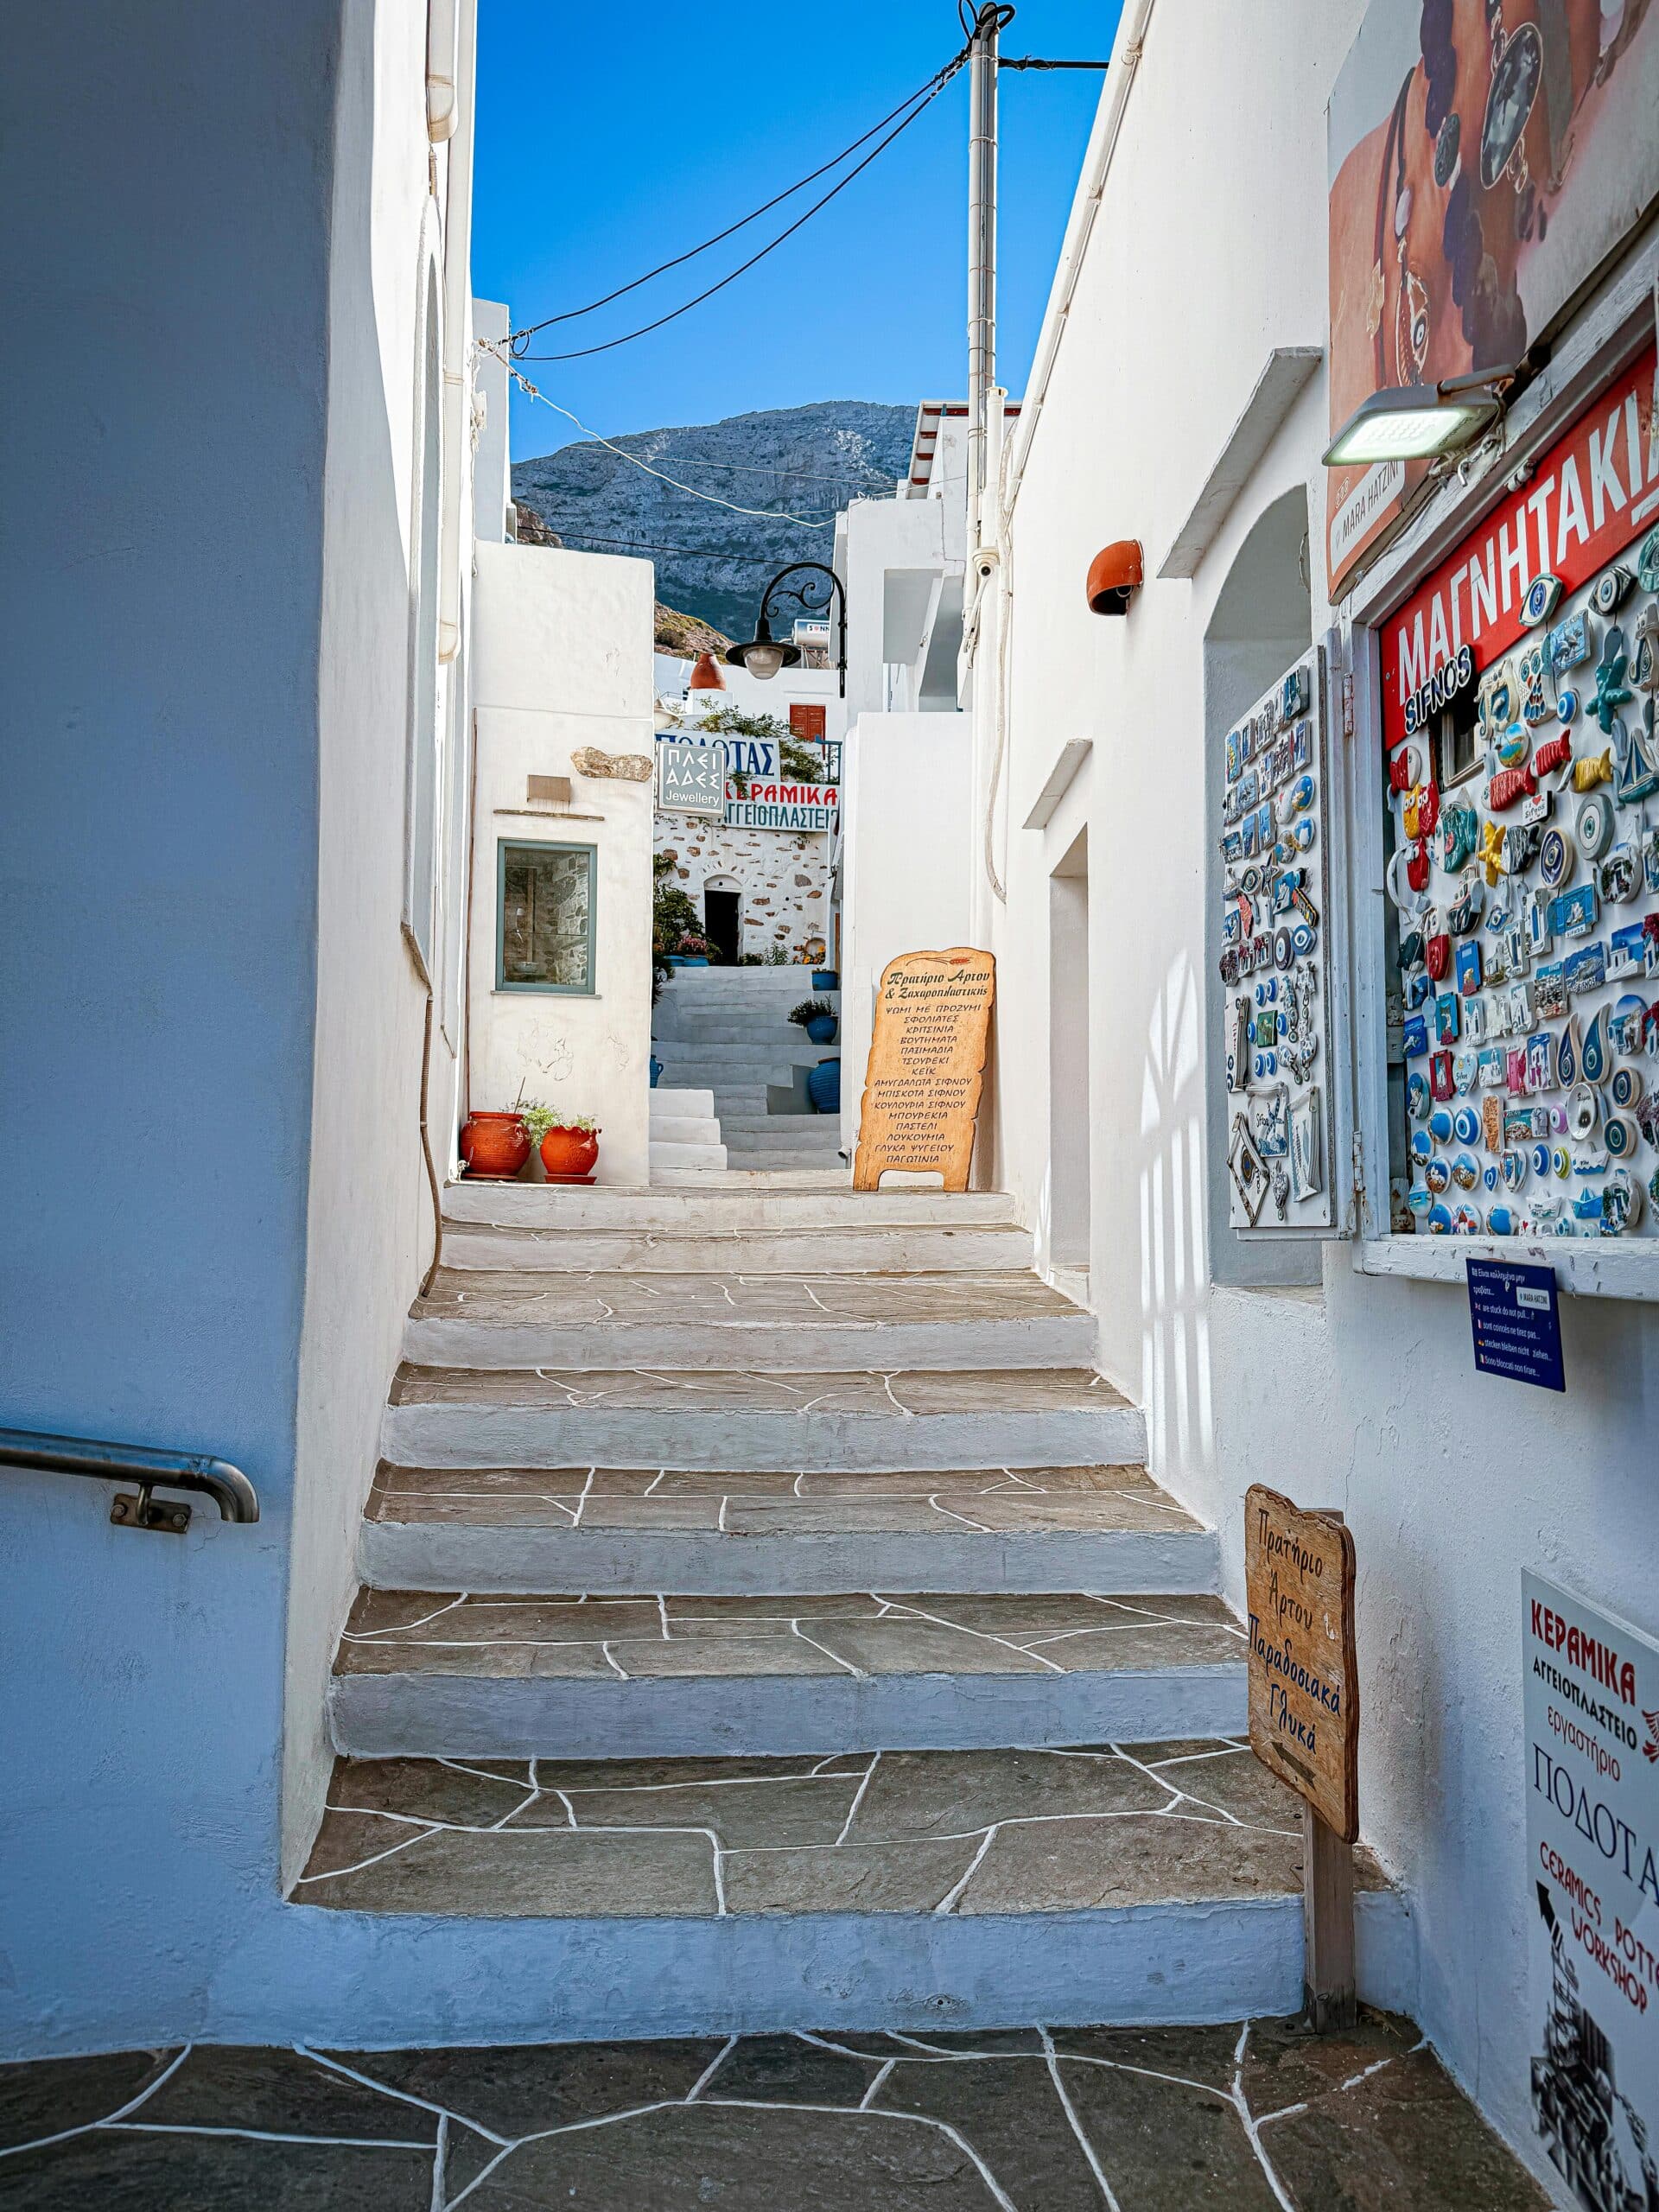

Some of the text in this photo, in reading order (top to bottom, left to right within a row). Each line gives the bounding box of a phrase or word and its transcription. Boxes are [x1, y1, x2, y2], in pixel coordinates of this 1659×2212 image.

[1343, 496, 1365, 543] MARA
[1405, 644, 1472, 734] SIFNOS
[668, 749, 716, 770] ΠΛΕΙ
[665, 768, 720, 790] ΑΔΕΣ
[665, 790, 719, 807] Jewellery
[887, 972, 944, 987] Πρατήριο
[886, 985, 988, 1000] & Ζαχαροπλαστικής
[904, 1014, 960, 1024] ΣΦΟΛΙΑΤΕΣ
[936, 1004, 981, 1013] ΠΡΟΖΥΜΙ
[900, 1035, 957, 1045] ΒΟΥΤΗΜΑΤΑ
[902, 1057, 950, 1065] ΤΣΟΥΡΕΚΙ
[874, 1077, 972, 1087] ΑΜΥΓΔΑΛΩΤΑ ΣΙΦΝΟΥ
[927, 1089, 966, 1097] ΣΙΦΝΟΥ
[874, 1144, 954, 1153] ΓΛΥΚΑ ΨΥΓΕΙΟΥ
[1258, 1508, 1323, 1579] Πρατήριο
[1268, 1570, 1313, 1630] Άρτου
[1531, 1599, 1636, 1707] ΚΕΡΑΜΙΚΑ
[1249, 1613, 1341, 1719] Παραδοσιακά
[1533, 1656, 1637, 1751] ΑΓΓΕΙΟΠΛΑΣΤΕΙΟ
[1270, 1683, 1316, 1755] Γλυκά
[1548, 1705, 1620, 1783] εργαστήριο
[1540, 1840, 1601, 1926] CERAMICS
[1571, 1906, 1648, 2015] WORKSHOP
